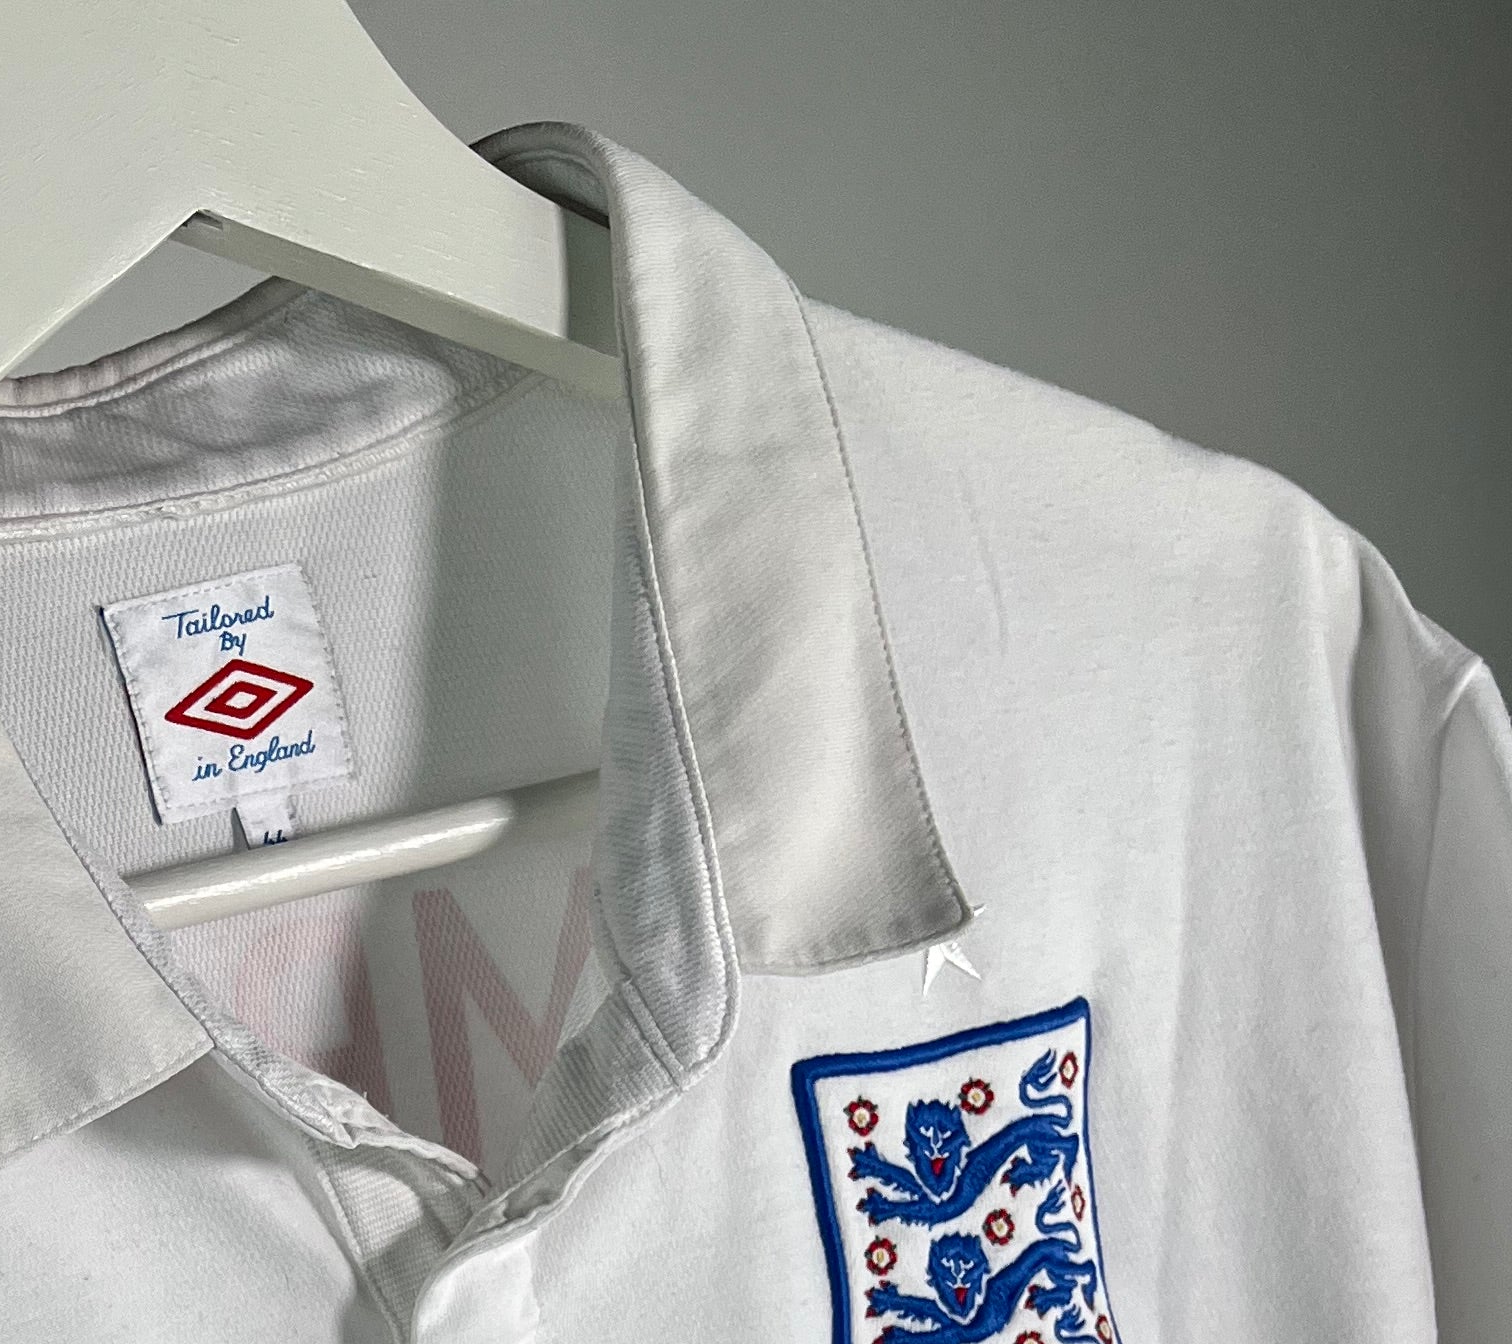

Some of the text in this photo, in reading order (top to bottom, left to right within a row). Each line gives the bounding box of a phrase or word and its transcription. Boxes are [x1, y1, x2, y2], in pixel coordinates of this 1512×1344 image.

[161, 595, 274, 639] Tailored
[219, 631, 247, 656] By
[192, 729, 316, 782] in England
